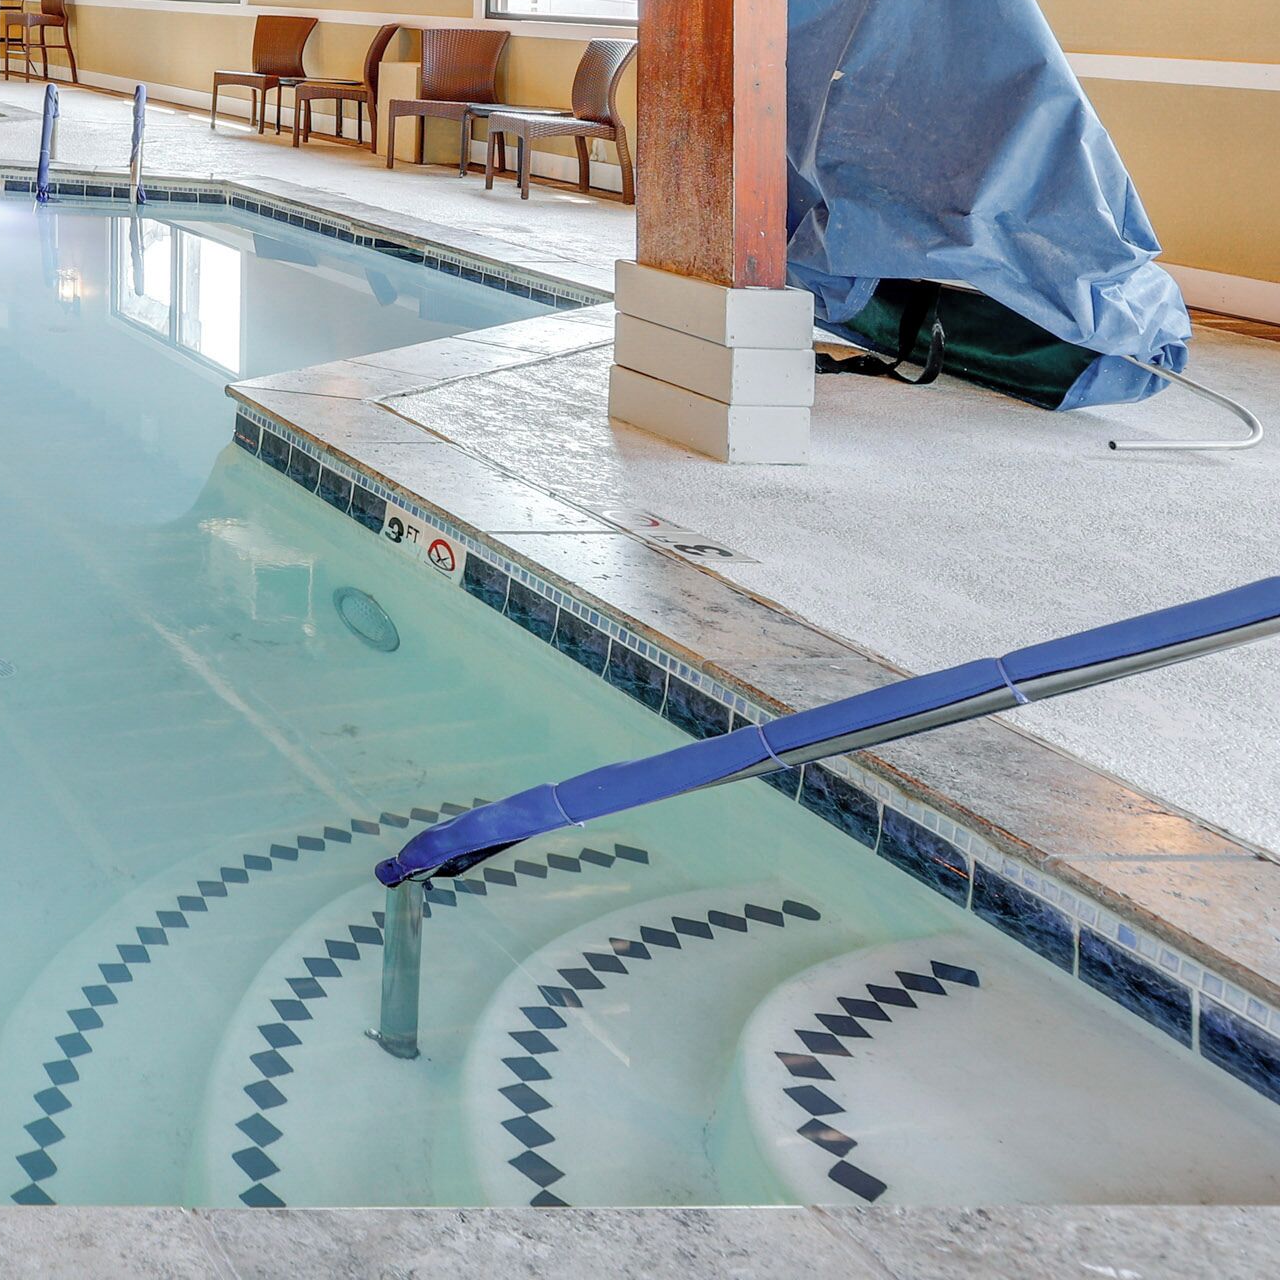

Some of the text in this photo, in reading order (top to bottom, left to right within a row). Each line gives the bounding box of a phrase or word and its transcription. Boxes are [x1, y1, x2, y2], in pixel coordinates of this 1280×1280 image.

[385, 517, 420, 544] 3 FT
[673, 544, 734, 557] 3
